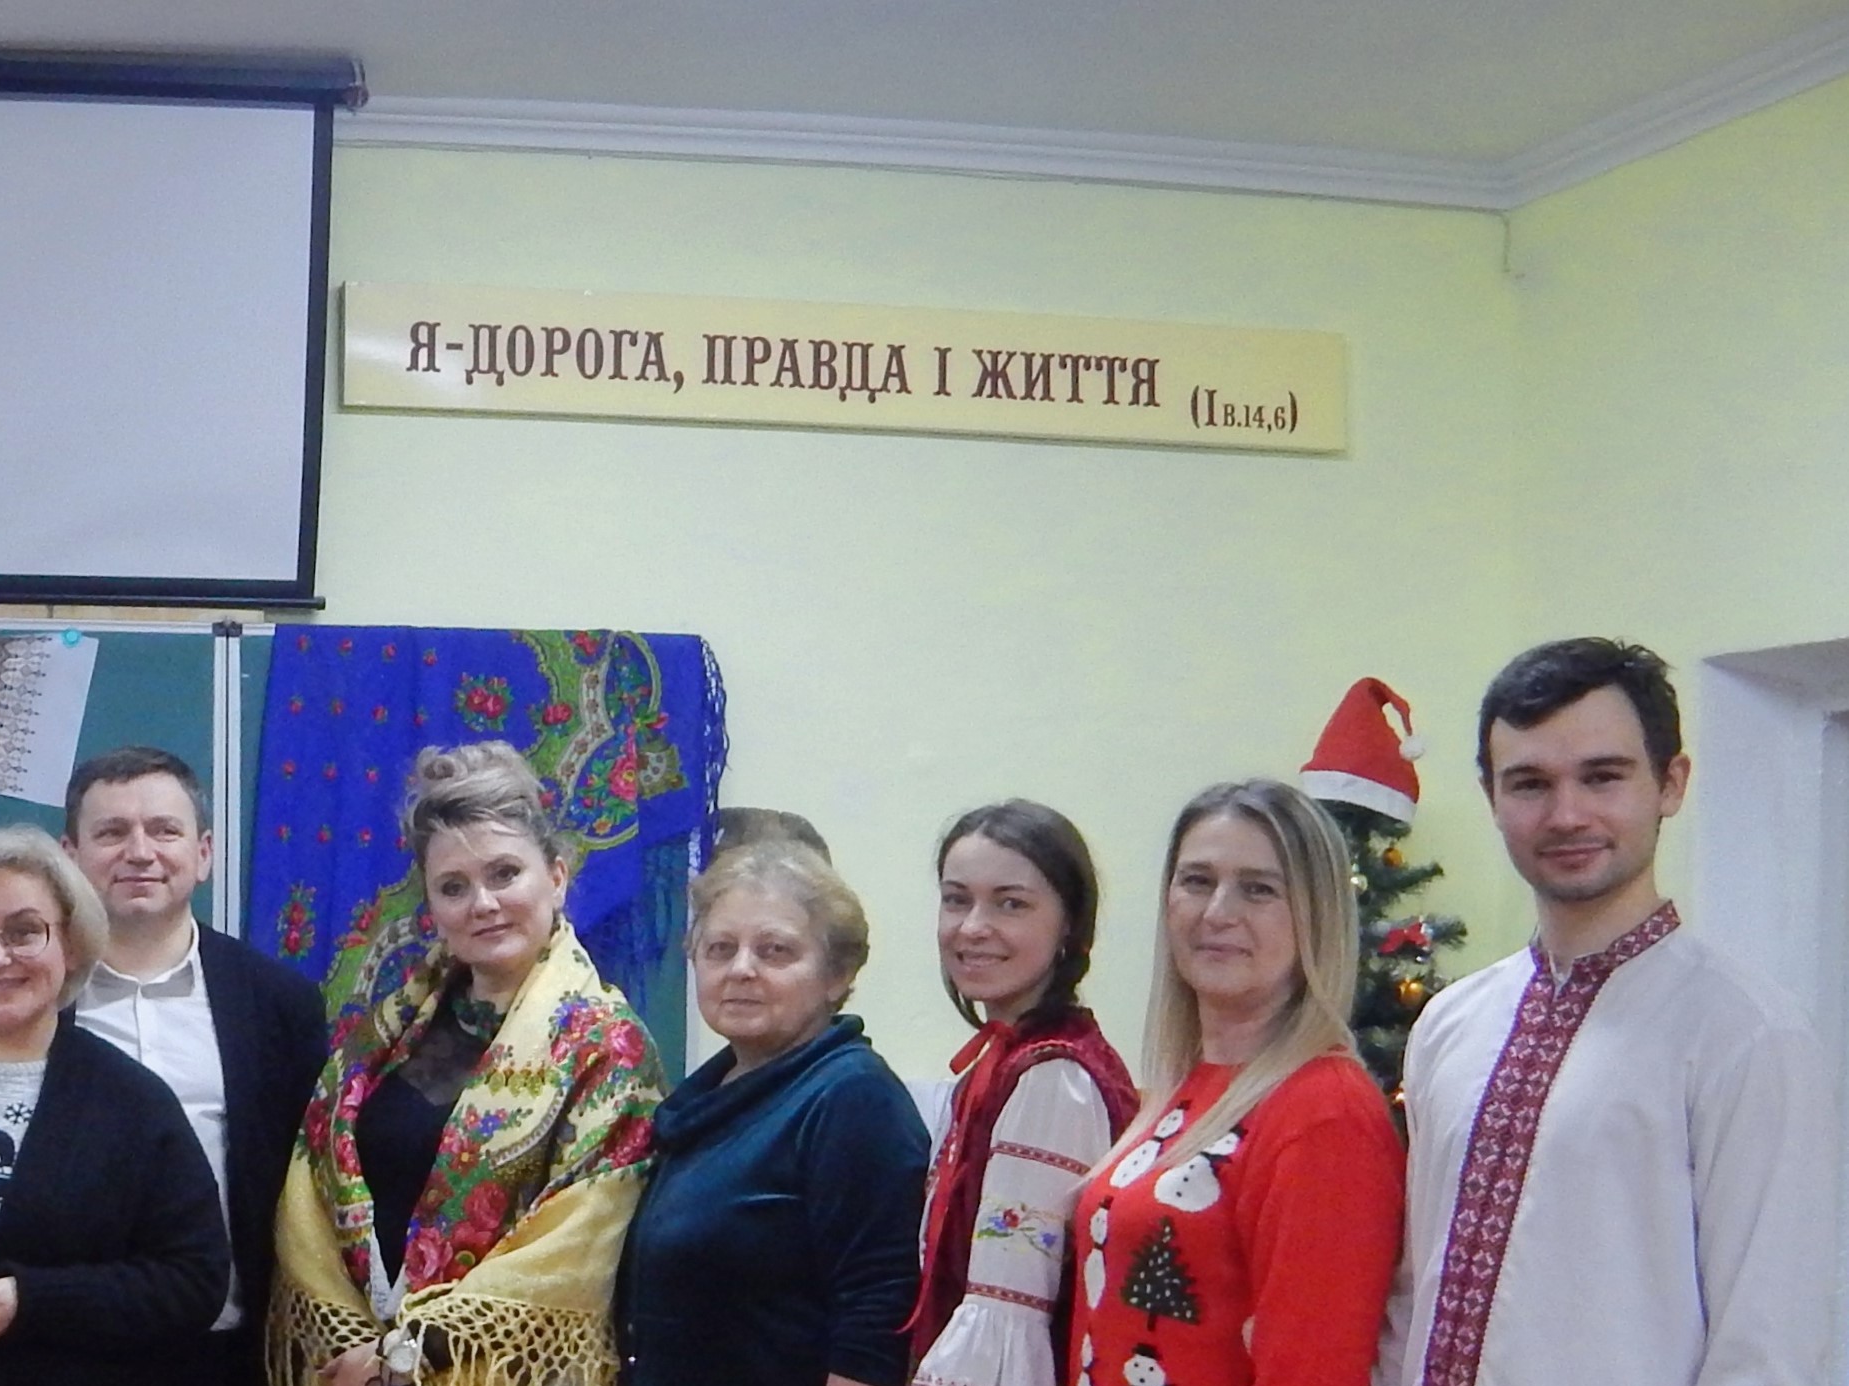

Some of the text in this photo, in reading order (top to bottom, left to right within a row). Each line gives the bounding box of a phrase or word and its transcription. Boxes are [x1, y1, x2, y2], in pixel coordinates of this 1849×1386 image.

[405, 320, 685, 395] Я-ДОРОГА,
[701, 332, 912, 404] ПРАВДА
[970, 347, 1161, 408] ЖИТТЯ
